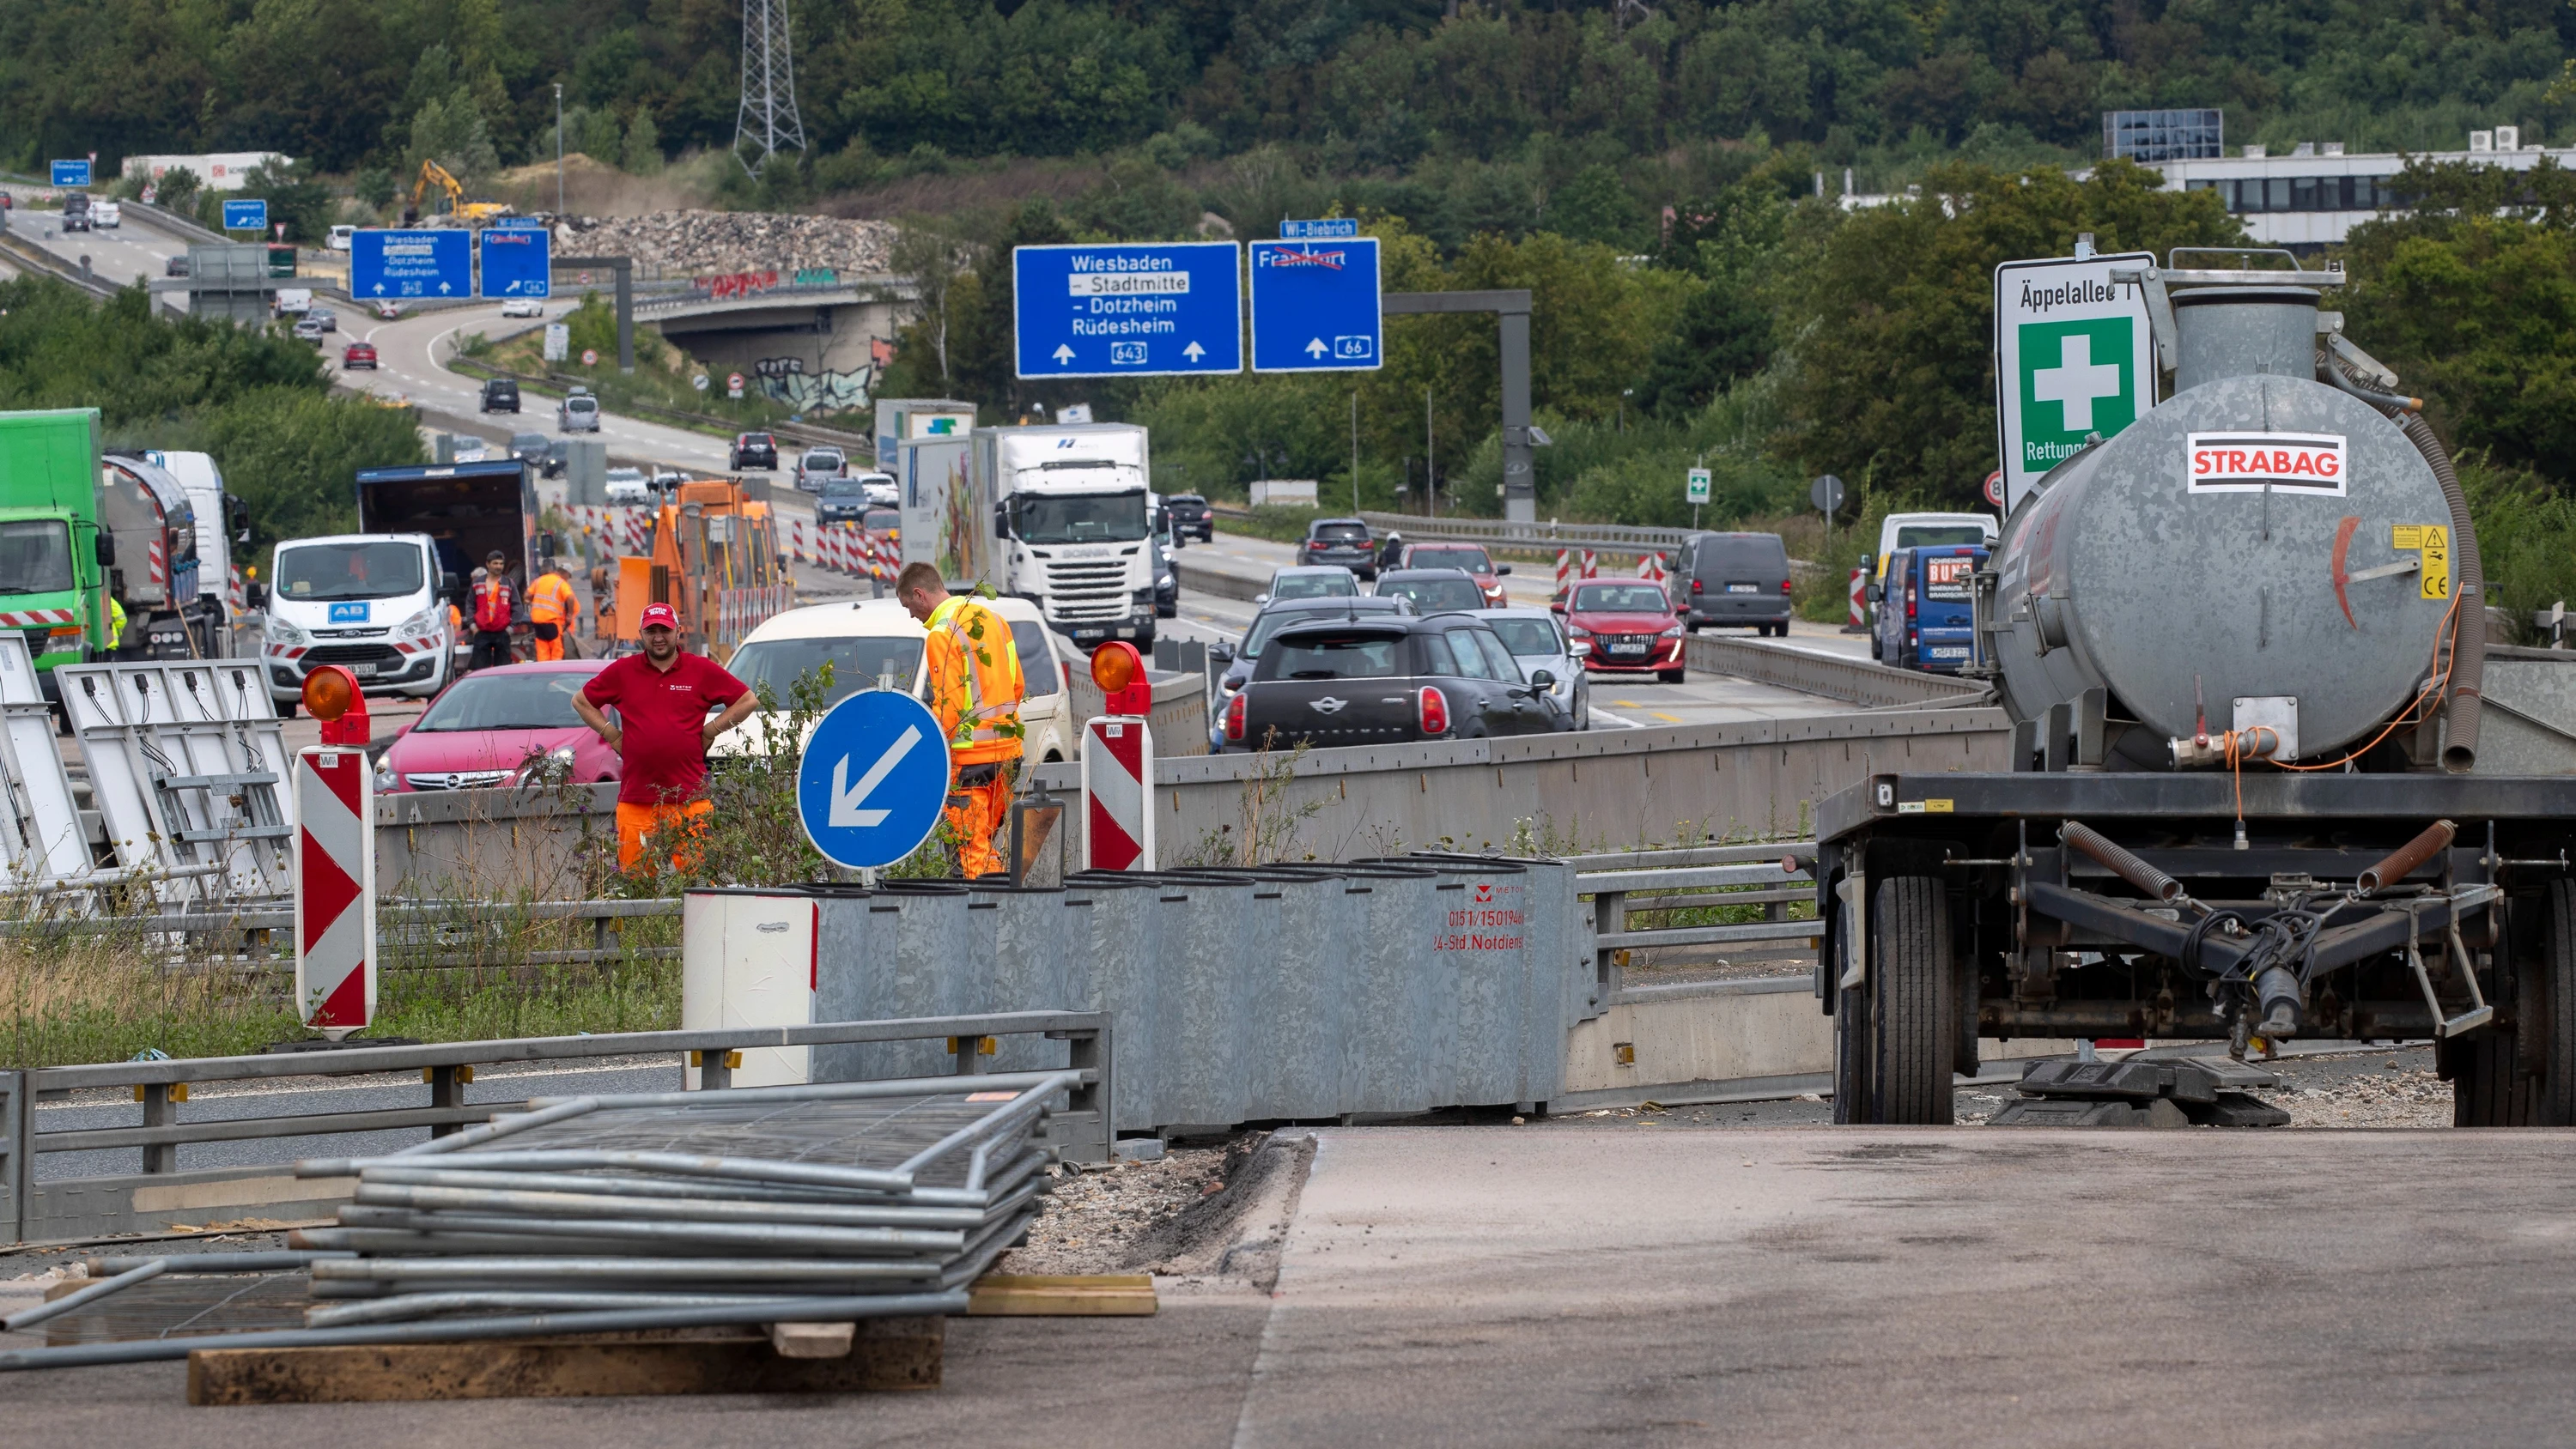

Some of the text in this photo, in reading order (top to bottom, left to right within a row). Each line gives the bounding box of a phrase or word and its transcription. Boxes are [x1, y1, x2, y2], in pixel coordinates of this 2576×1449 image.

[1285, 221, 1353, 236] WI-Biebrich
[1071, 254, 1173, 272] Wiesbaden
[1091, 275, 1187, 293] Stadtmitte
[1091, 295, 1177, 314] Dotzheim
[1072, 317, 1176, 335] Rüdesheim
[1116, 345, 1143, 361] 643
[1345, 340, 1362, 355] 66
[2194, 451, 2340, 477] STRABAG
[334, 605, 365, 617] AB
